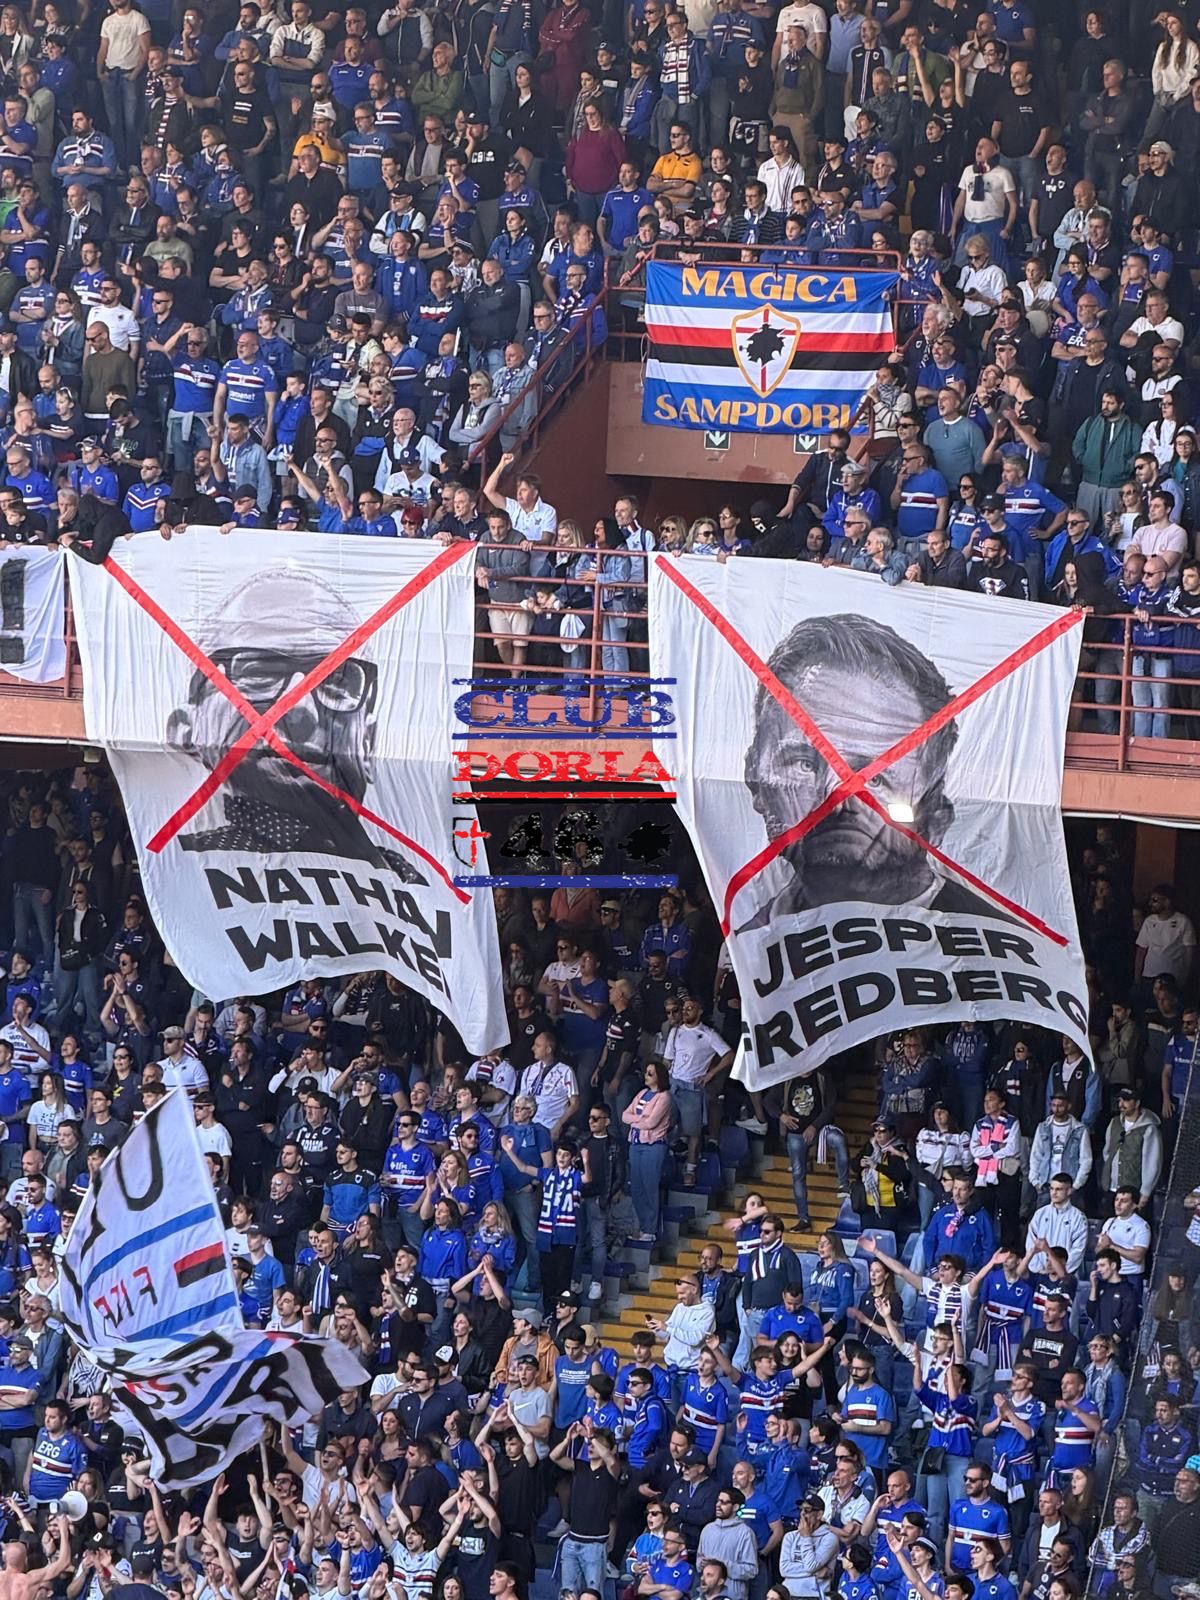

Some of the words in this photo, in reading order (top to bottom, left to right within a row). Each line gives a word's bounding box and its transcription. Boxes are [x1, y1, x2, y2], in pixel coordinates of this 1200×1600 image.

[682, 268, 857, 302] MAGICA
[654, 393, 853, 429] SAMPDORI
[205, 867, 452, 958] NATHAN
[226, 920, 452, 1002] WALKE
[754, 918, 1041, 998] JESPER
[37, 1441, 61, 1459] ERG
